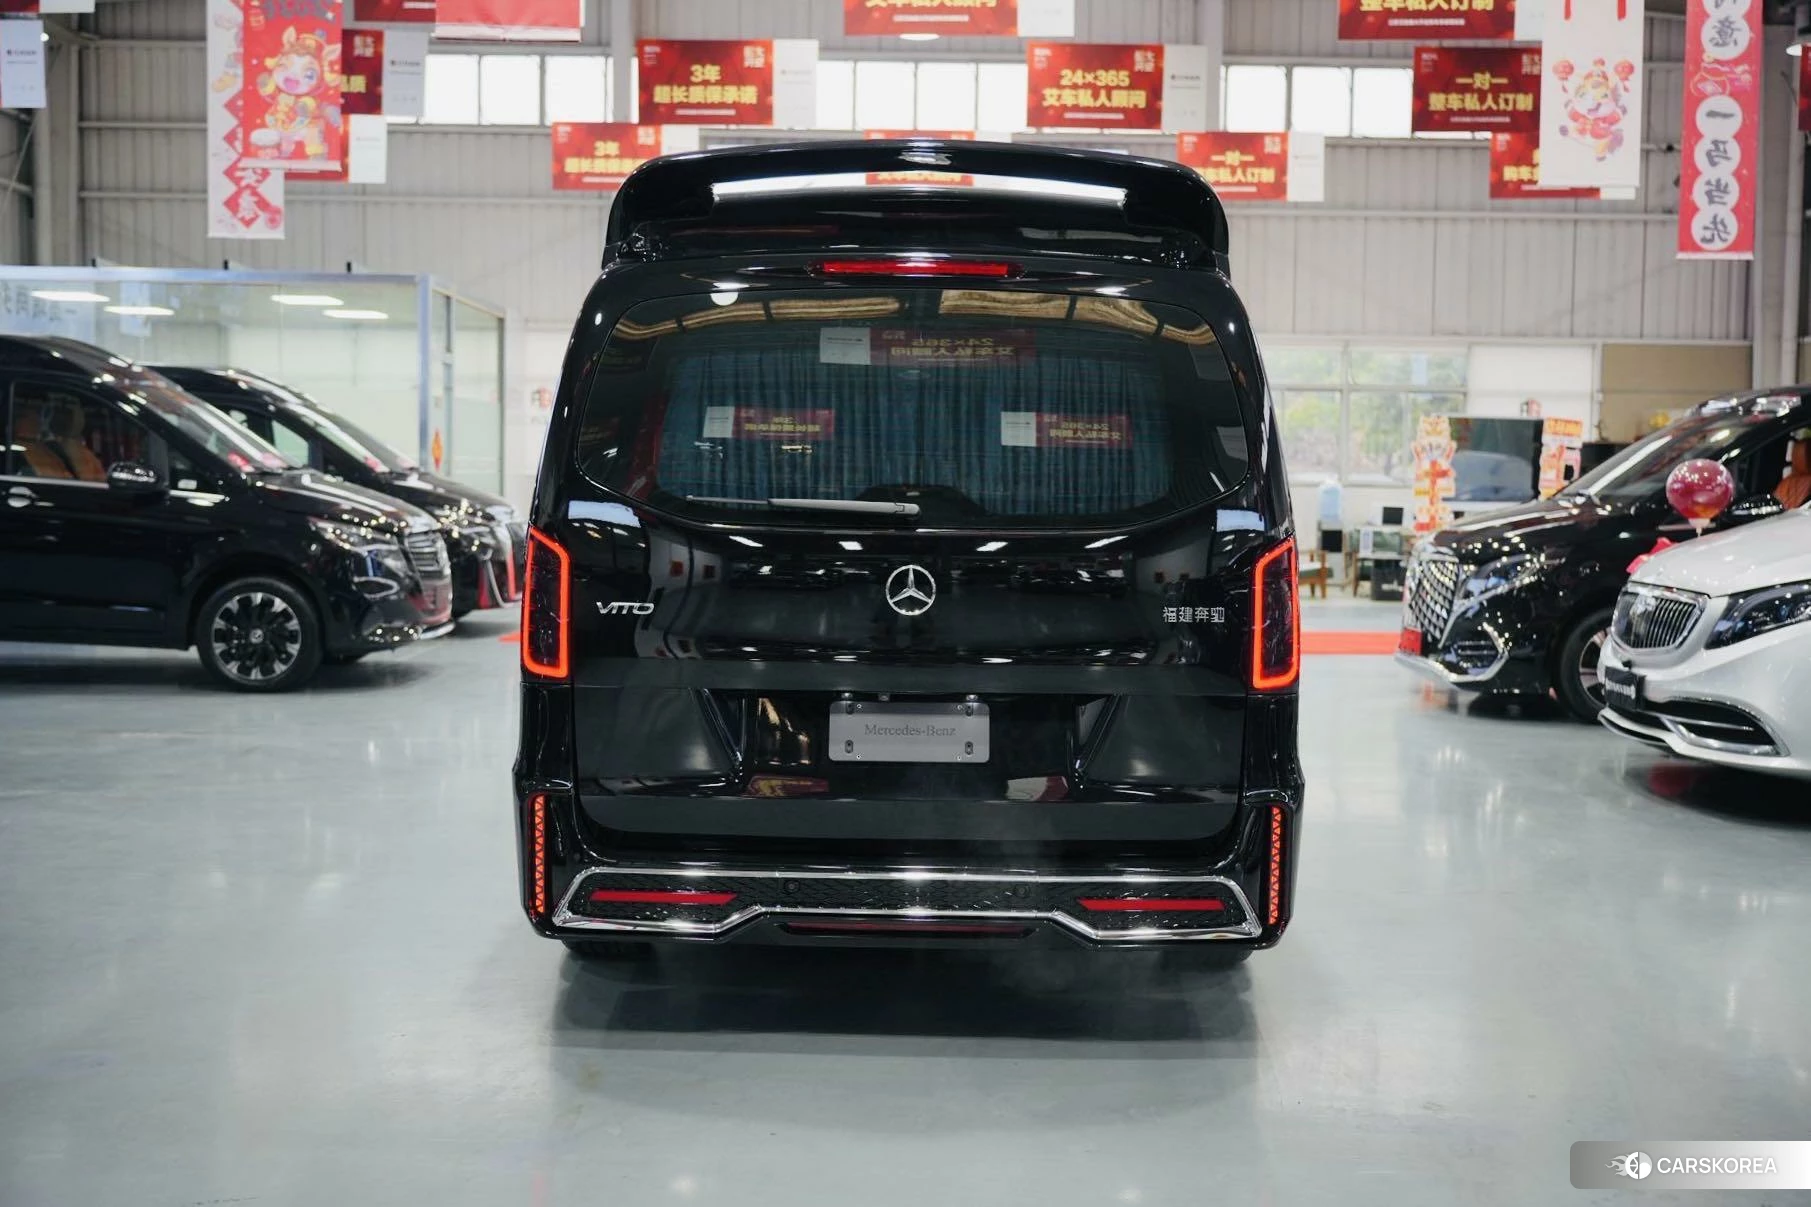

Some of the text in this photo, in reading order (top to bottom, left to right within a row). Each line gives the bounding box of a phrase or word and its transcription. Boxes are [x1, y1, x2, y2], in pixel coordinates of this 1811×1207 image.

[1455, 71, 1508, 89] 一对一
[596, 601, 655, 615] VITO
[1163, 606, 1225, 623] 福建奔驰
[864, 723, 957, 737] Mercedes-Benz
